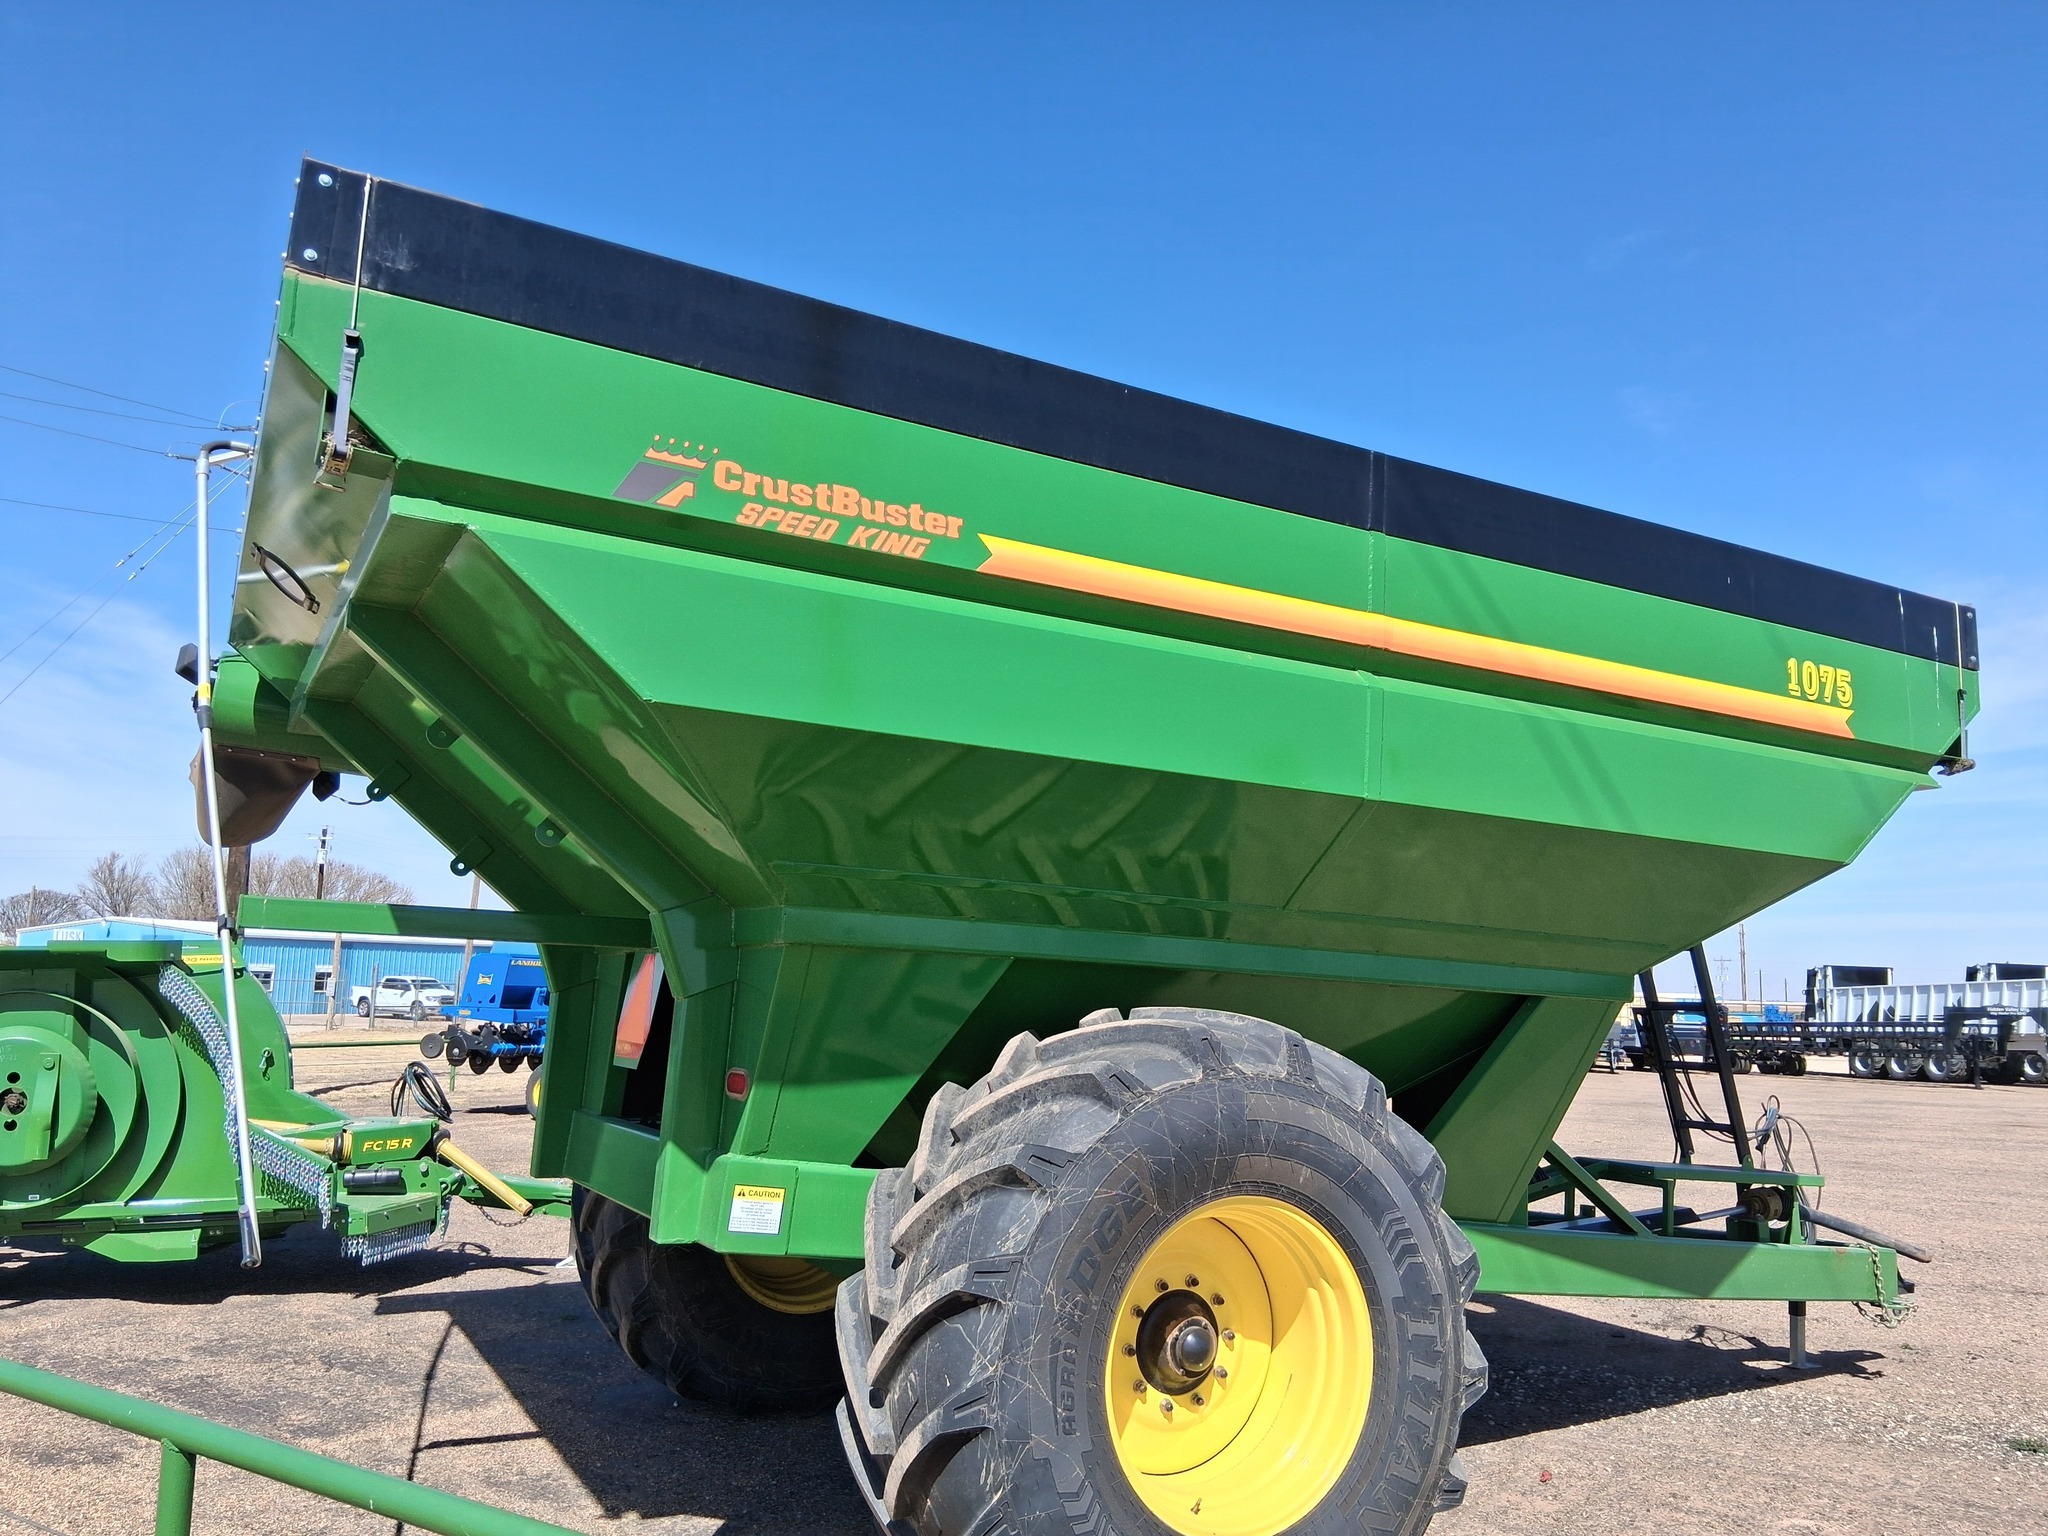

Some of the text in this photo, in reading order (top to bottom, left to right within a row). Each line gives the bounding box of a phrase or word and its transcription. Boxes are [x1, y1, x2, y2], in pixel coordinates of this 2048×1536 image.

[713, 459, 964, 539] CrustBuster
[736, 502, 931, 560] SPEED KING
[1787, 657, 1853, 708] 1075
[748, 1189, 781, 1199] CAUTION
